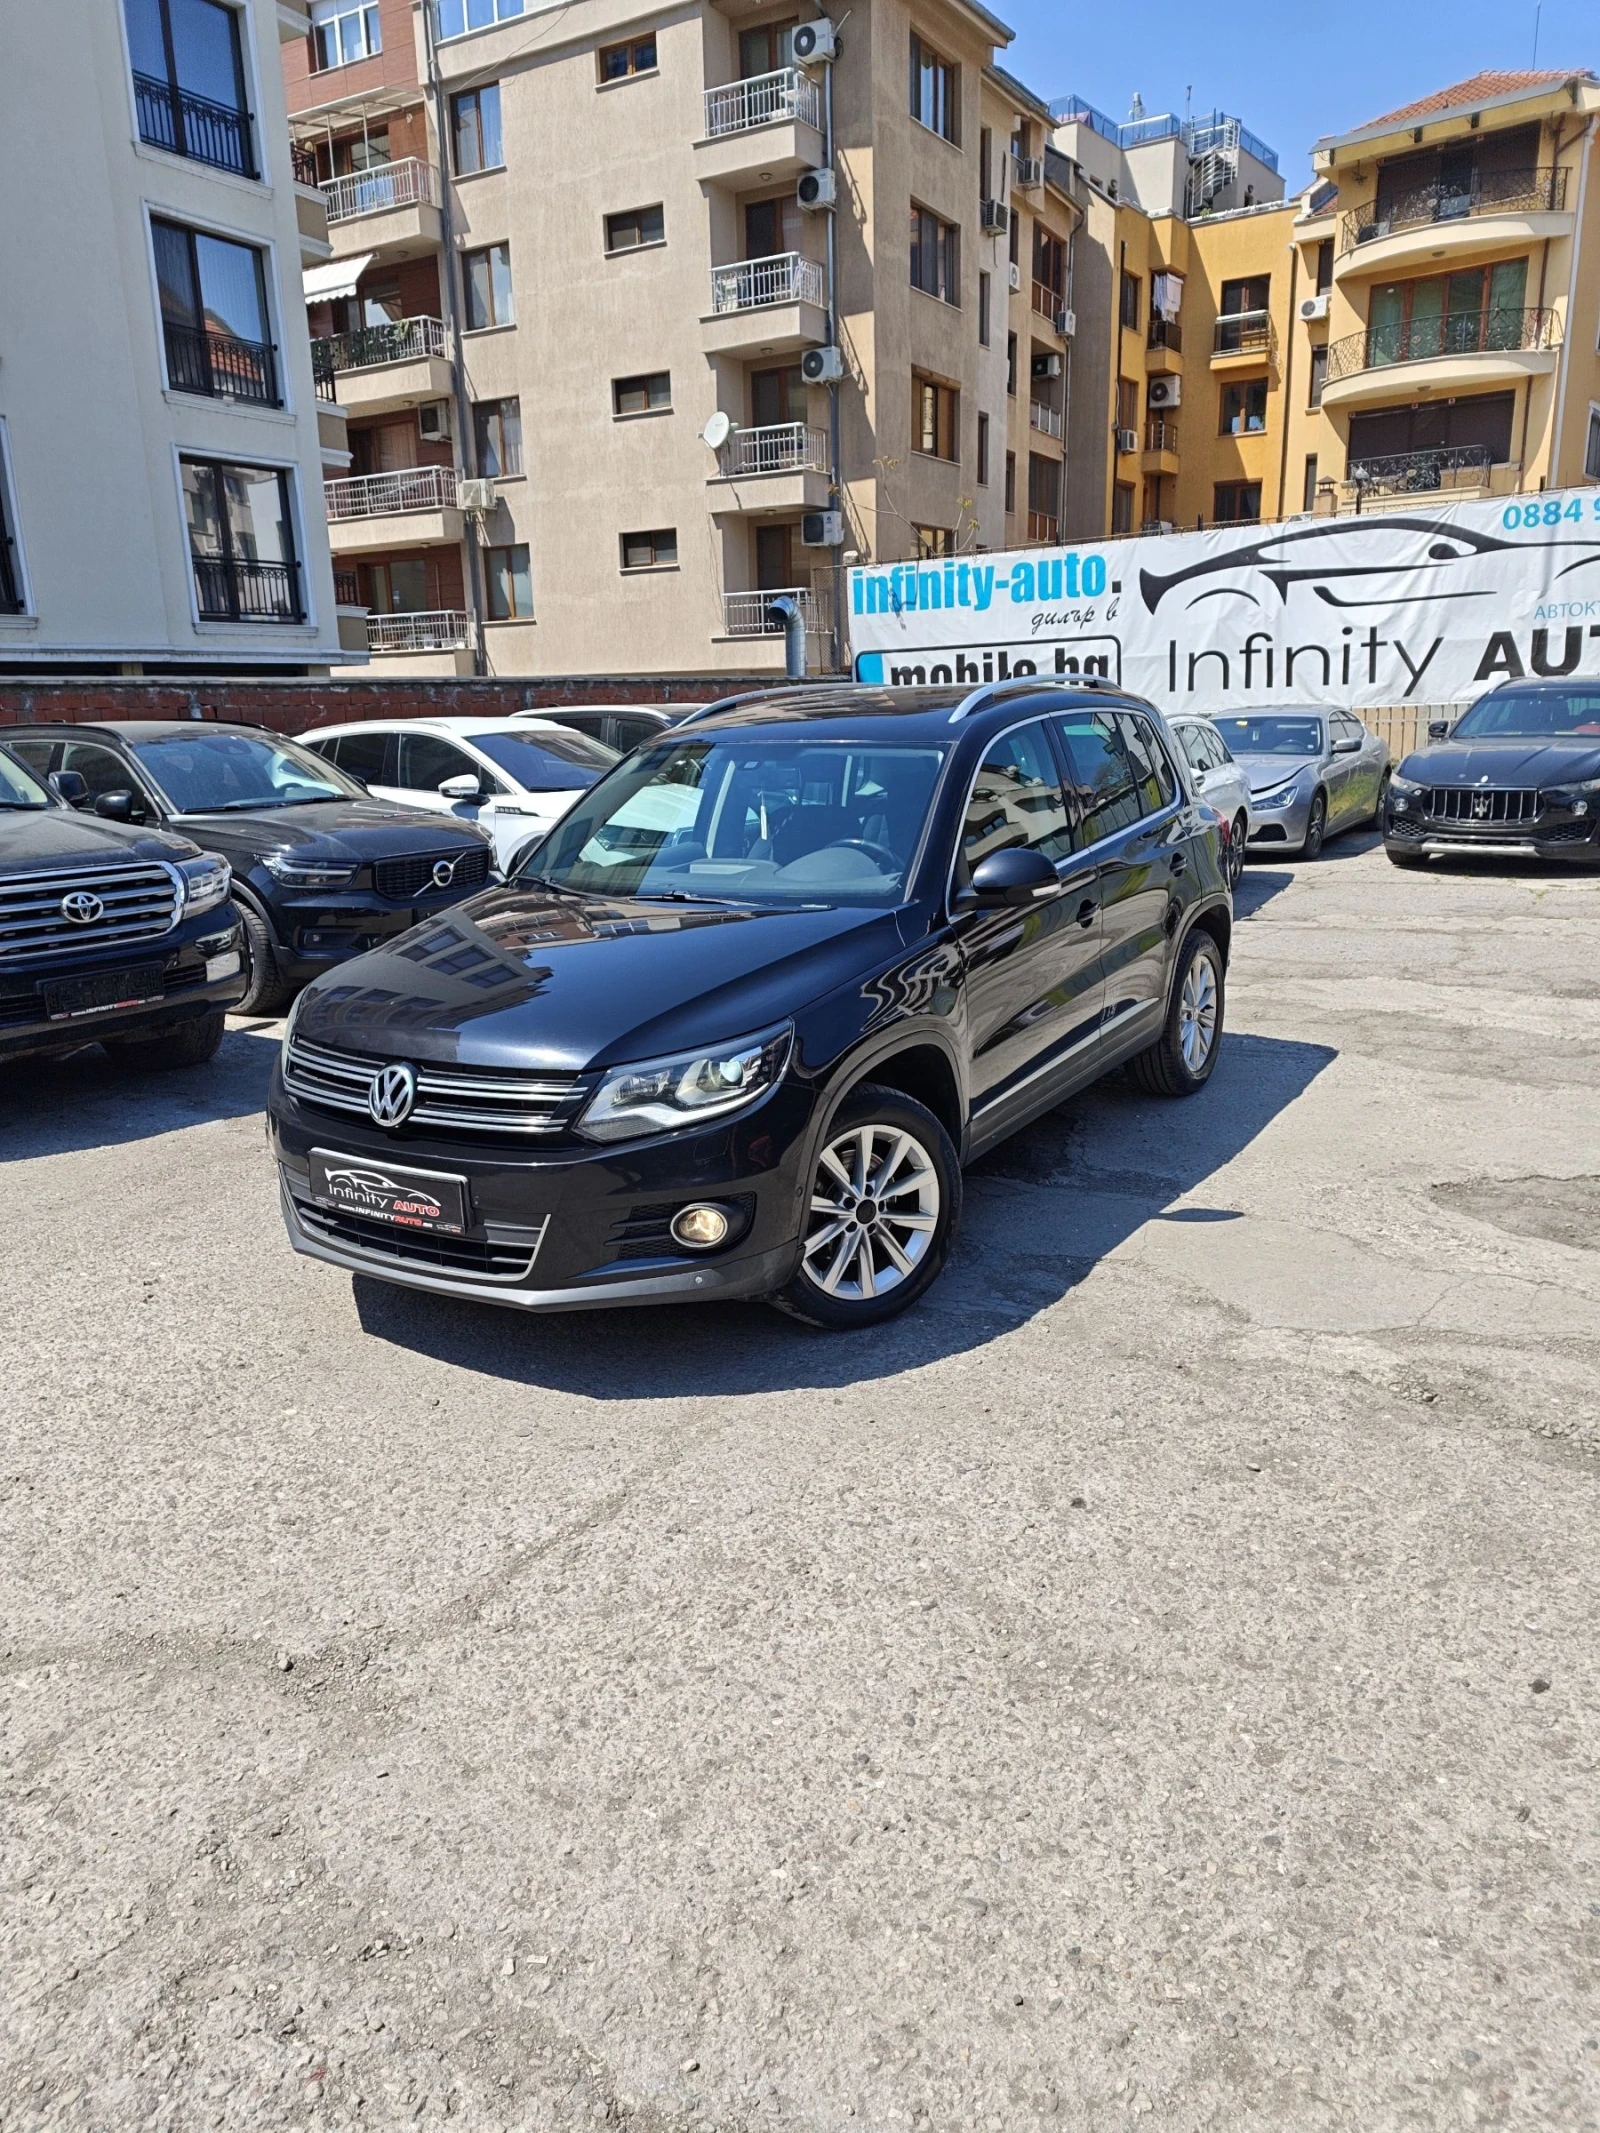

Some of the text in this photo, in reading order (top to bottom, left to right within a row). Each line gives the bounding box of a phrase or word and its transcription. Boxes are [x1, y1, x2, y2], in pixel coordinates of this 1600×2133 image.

[1502, 498, 1583, 530] 0884
[1533, 600, 1600, 620] АВТОК
[891, 647, 1109, 686] mobilebg
[1168, 626, 1444, 697] Infinity
[328, 1183, 388, 1209] Infinity
[393, 1200, 440, 1217] AUTO
